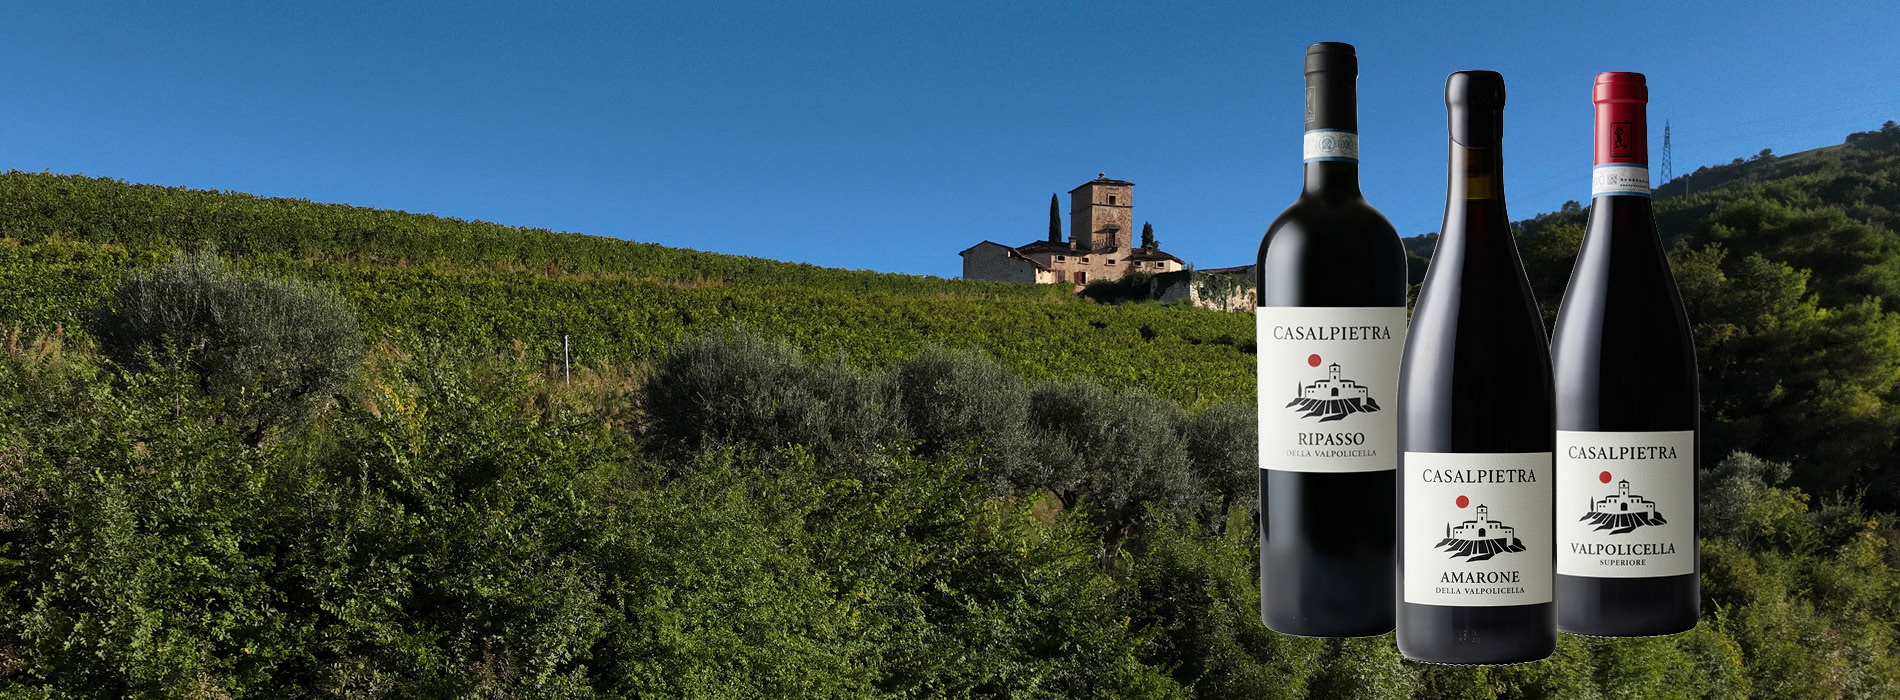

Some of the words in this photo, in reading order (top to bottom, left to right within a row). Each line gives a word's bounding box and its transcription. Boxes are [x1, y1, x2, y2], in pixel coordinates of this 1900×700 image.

[1273, 325, 1391, 340] CASALPIETRA
[1298, 432, 1365, 446] RIPASSO
[1286, 449, 1311, 457] DELLA
[1315, 449, 1377, 458] VALPOLICELLA
[1568, 445, 1677, 459] CASALPIETRA
[1422, 468, 1537, 483] CASALPIETRA
[1571, 542, 1676, 556] VALPOLICELLA
[1440, 571, 1521, 584] AMARONE
[1435, 586, 1461, 594] DELLA
[1464, 586, 1525, 595] VALPOLICELLA
